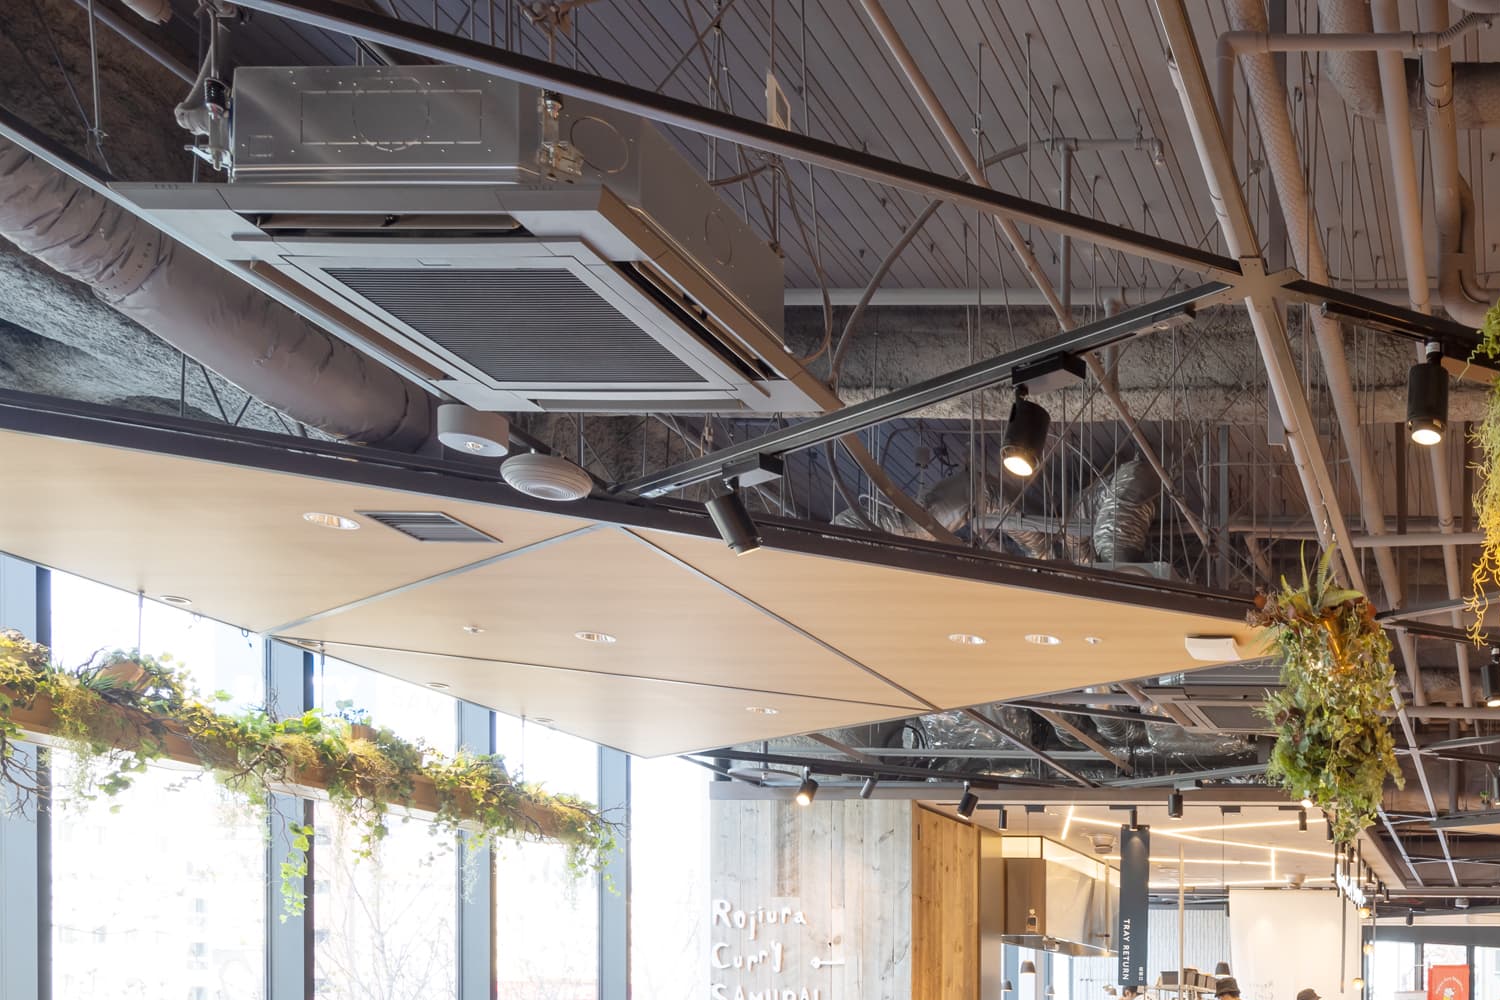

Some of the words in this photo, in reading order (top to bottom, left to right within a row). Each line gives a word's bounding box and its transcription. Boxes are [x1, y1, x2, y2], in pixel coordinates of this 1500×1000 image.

[711, 898, 808, 941] Rojiura
[1122, 918, 1131, 942] TRAY
[711, 940, 783, 974] Curry
[1122, 944, 1130, 981] RETURN
